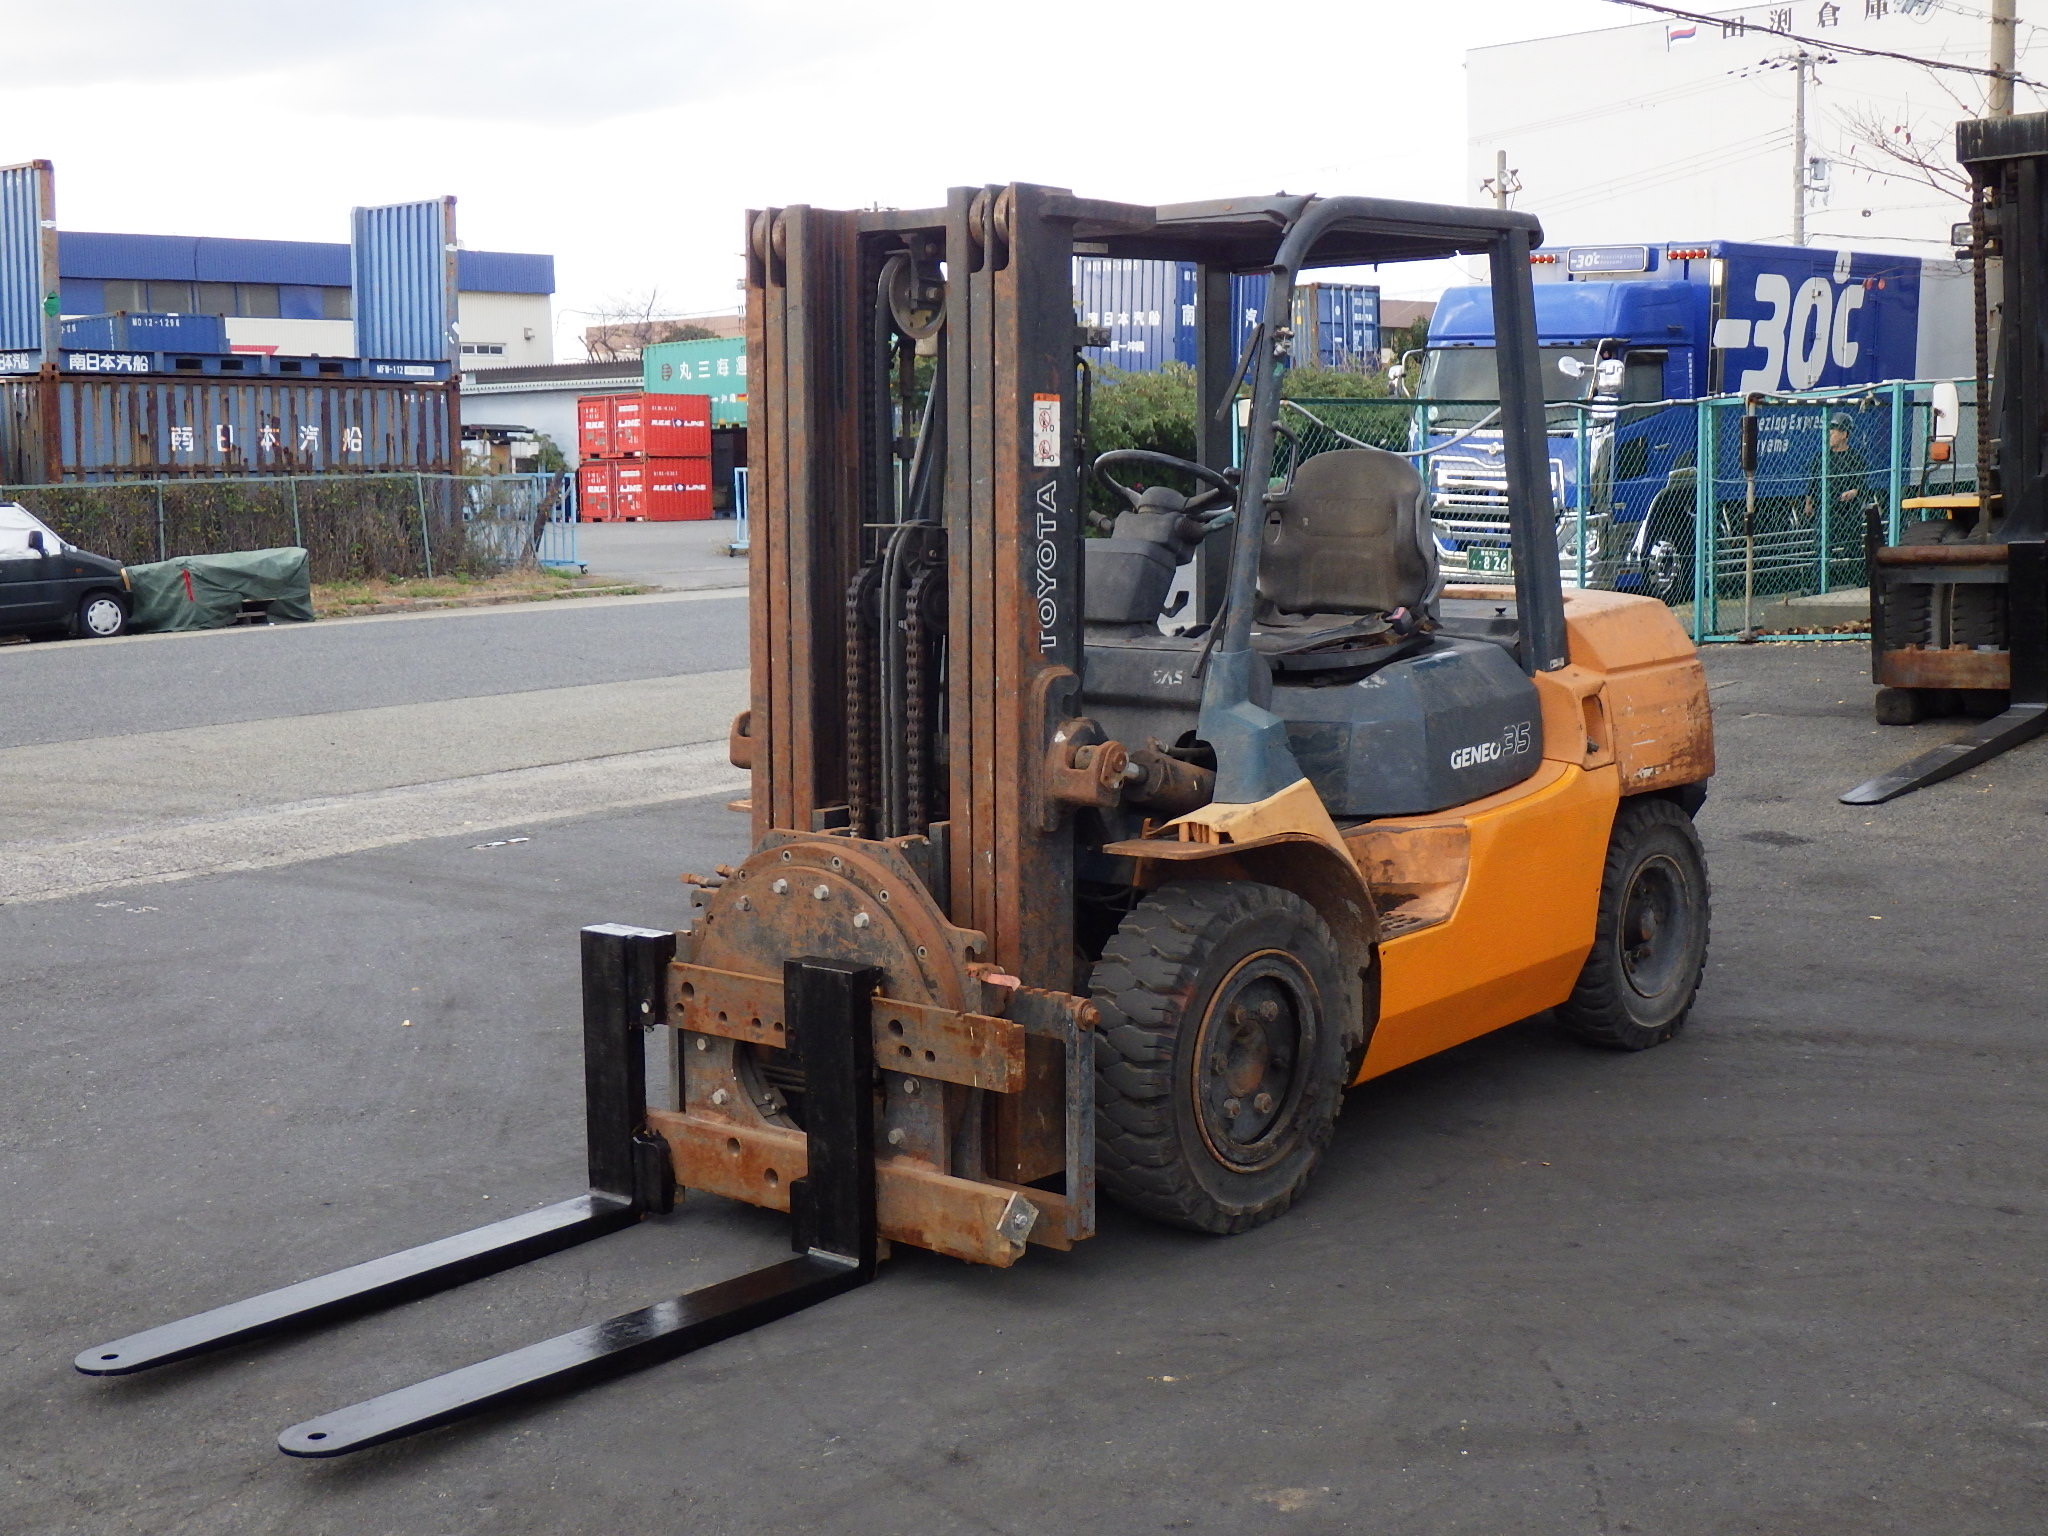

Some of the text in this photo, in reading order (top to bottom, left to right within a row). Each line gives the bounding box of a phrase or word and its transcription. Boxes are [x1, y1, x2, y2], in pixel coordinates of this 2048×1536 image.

[69, 353, 149, 372] 南日本汽船
[1758, 414, 1824, 434] ezing Expres
[171, 425, 362, 451] 南日本汽船
[1037, 480, 1057, 653] TOYOTA
[1450, 720, 1531, 770] GENEO 35
